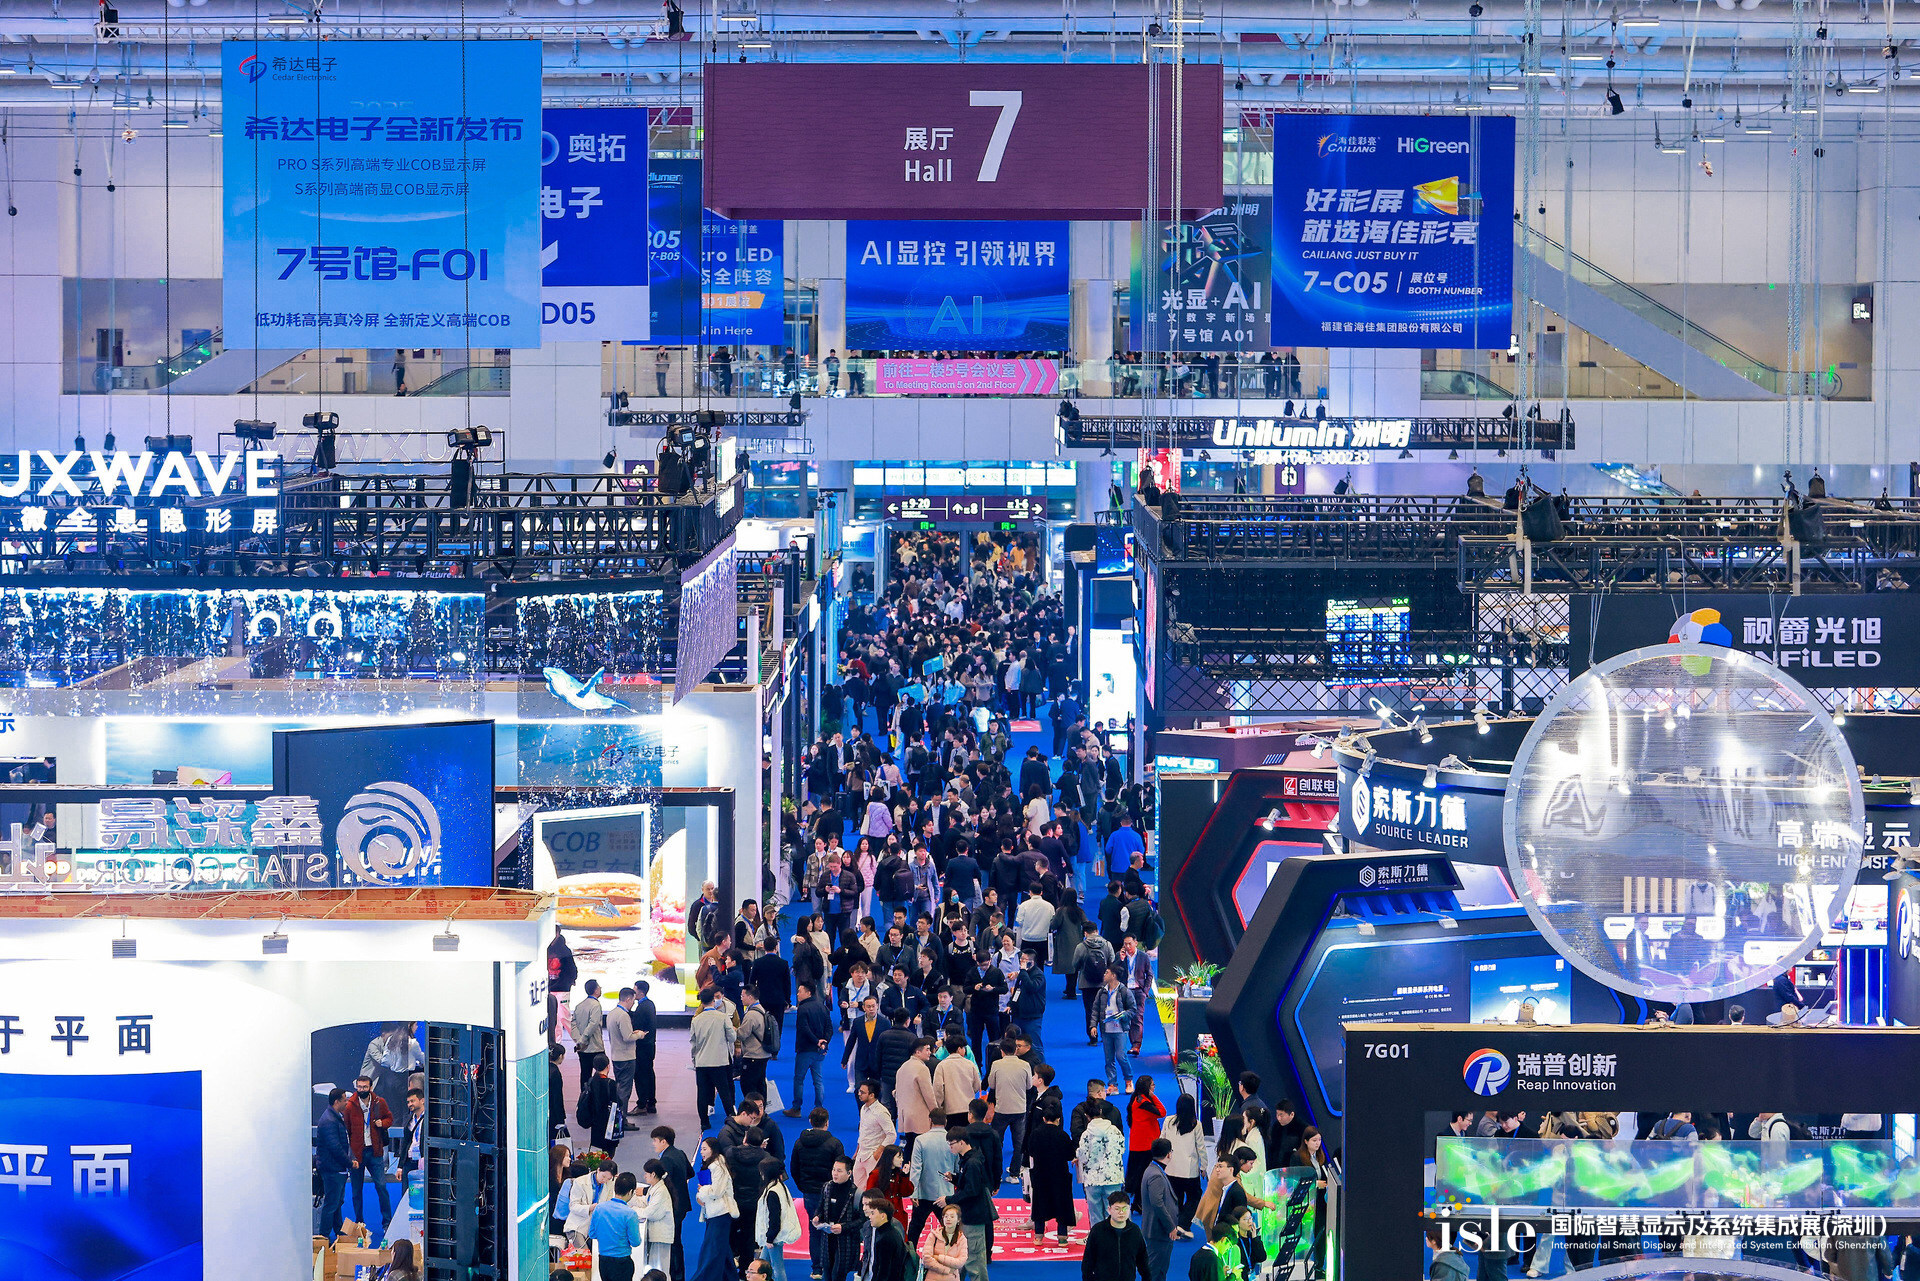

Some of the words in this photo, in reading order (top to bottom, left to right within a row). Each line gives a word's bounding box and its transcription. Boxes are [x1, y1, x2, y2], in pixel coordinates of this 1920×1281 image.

[272, 56, 338, 72] 希达电子
[244, 116, 524, 142] 希达电子全新发布
[969, 90, 1023, 182] 7
[568, 133, 627, 163] 奥拓
[903, 128, 954, 152] 展厅
[1397, 137, 1470, 154] HiGreen
[277, 158, 307, 171] PRO
[311, 157, 487, 172] S系列高端专业COB显示屏
[904, 159, 953, 182] Hall
[294, 182, 471, 197] S系列高端商显COB显示屏
[541, 186, 603, 219] 电子
[1303, 188, 1405, 213] 好彩屏
[1301, 219, 1479, 245] 就选海佳彩亮
[735, 247, 774, 262] LED
[860, 241, 946, 266] AI显控
[955, 241, 1056, 266] 引领视界
[1302, 250, 1352, 260] CAILIANG
[1354, 251, 1381, 260] JUST
[1384, 251, 1406, 260] BUY
[1408, 252, 1419, 261] IT
[1303, 271, 1389, 294] 7-C05
[1410, 272, 1448, 284] 展位号
[1408, 286, 1441, 295] BOOTH
[1443, 287, 1483, 296] NUMBER
[255, 312, 380, 328] 低功耗高亮真冷屏
[384, 312, 511, 328] 全新定义高端COB
[927, 295, 983, 335] AI
[724, 326, 753, 336] Here
[1221, 330, 1254, 342] A01
[1321, 322, 1463, 333] 福建省海佳集团股份有限公司
[882, 362, 1017, 378] 前往二楼5号会议室
[884, 381, 894, 389] To
[896, 381, 929, 390] Meeting
[930, 381, 955, 389] Room
[957, 381, 962, 389] 5
[977, 381, 992, 389] 2nd
[994, 381, 1017, 389] Floor
[1350, 420, 1411, 447] 洲明
[1743, 617, 1882, 645] 视爵光旭
[1747, 647, 1882, 667] NFiLED
[1372, 786, 1467, 832] 索斯力德
[1375, 823, 1413, 841] SOURCE
[1418, 830, 1469, 848] LEADER
[1377, 863, 1429, 878] 索斯力德
[1364, 1043, 1410, 1059] 7G01
[1517, 1053, 1618, 1077] 瑞普创新
[1517, 1079, 1549, 1092] Reap
[1553, 1079, 1616, 1091] Innovation
